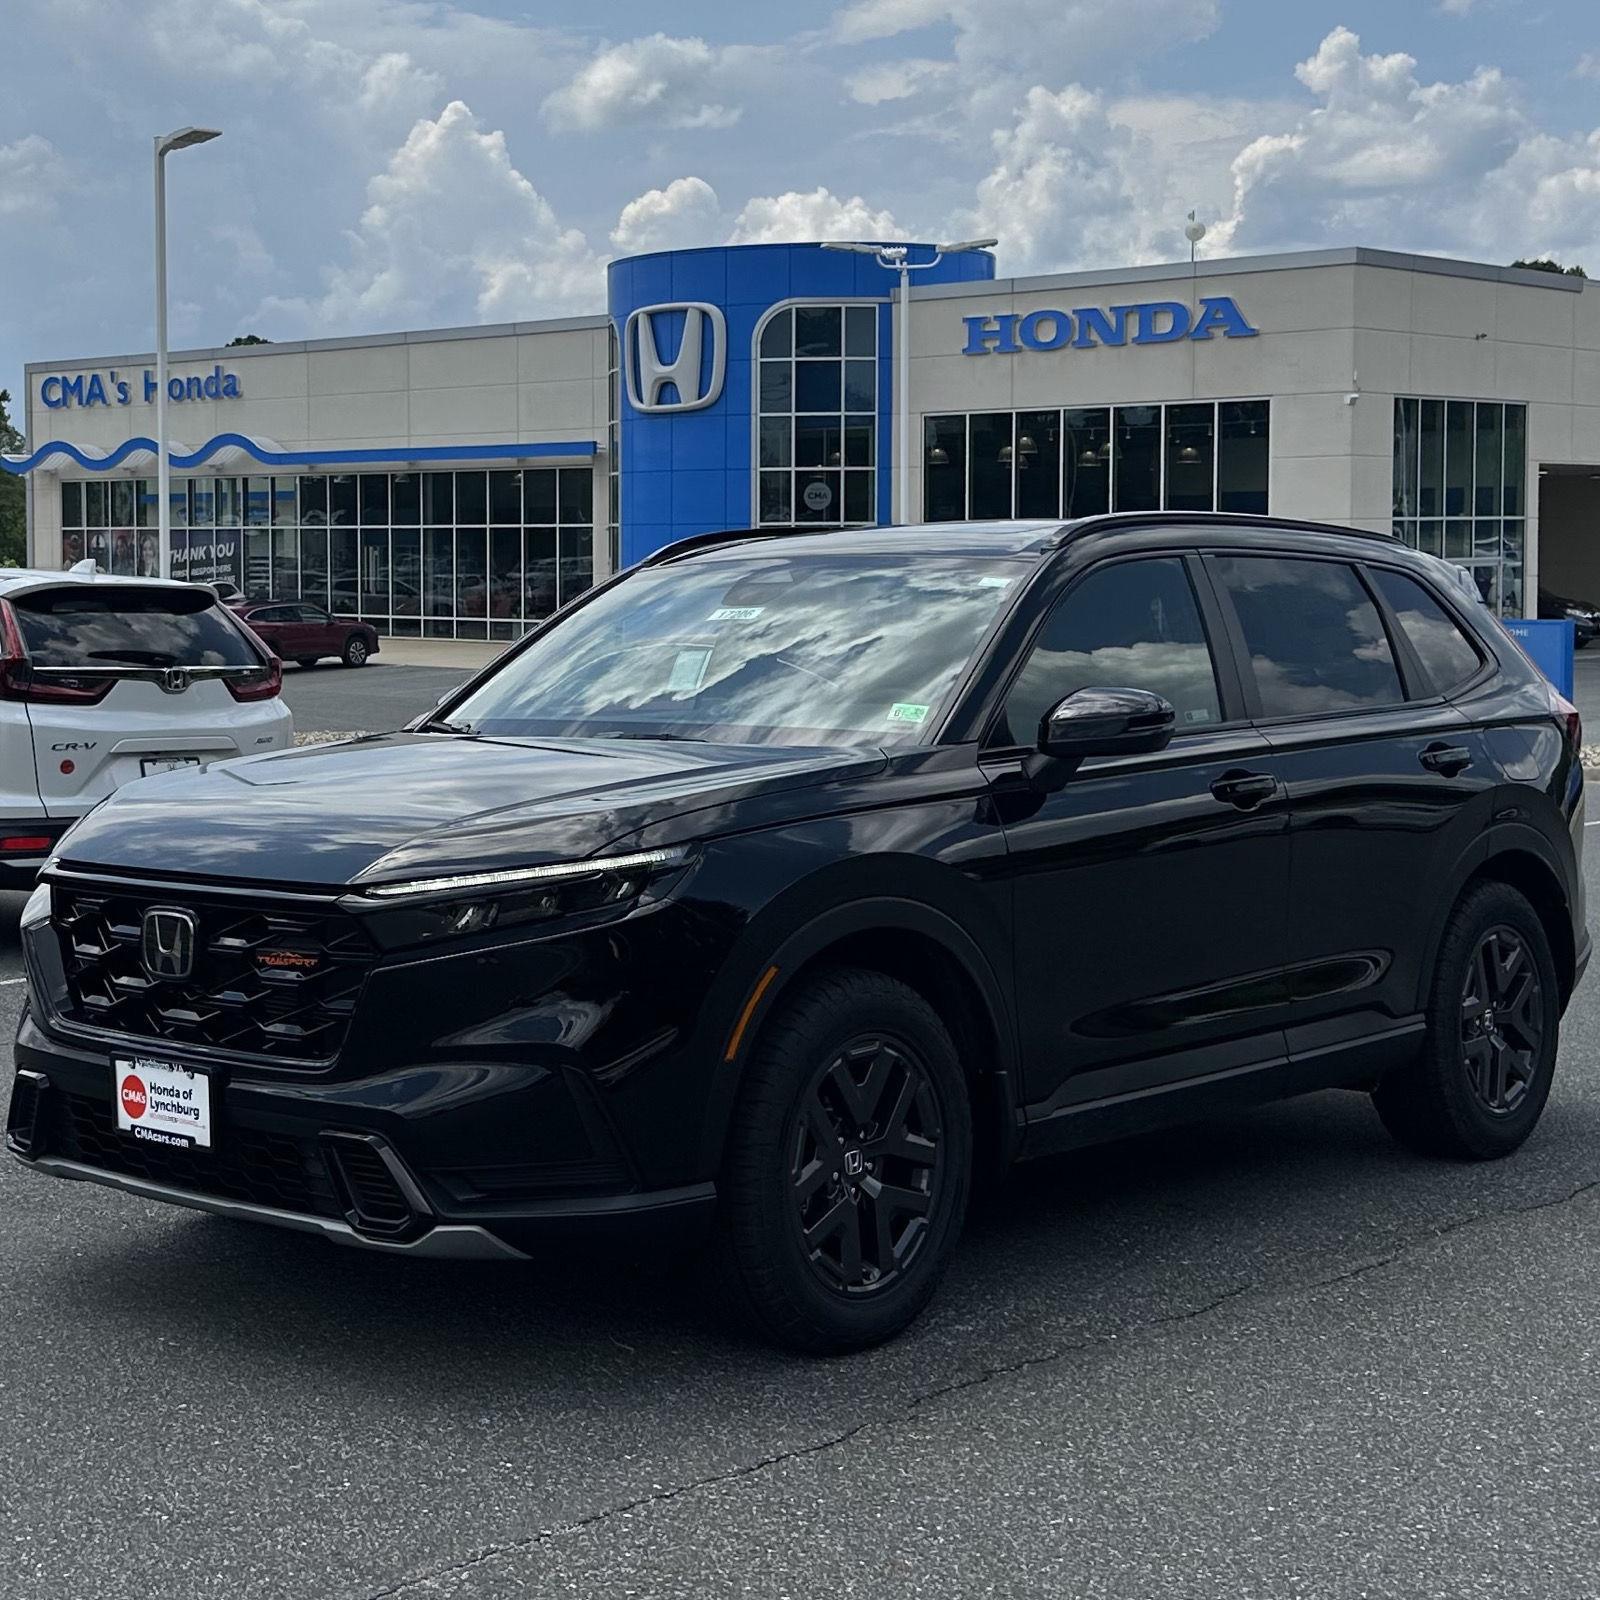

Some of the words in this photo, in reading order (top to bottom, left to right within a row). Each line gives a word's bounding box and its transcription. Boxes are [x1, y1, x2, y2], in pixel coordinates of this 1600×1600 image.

[961, 296, 1259, 355] HONDA
[41, 371, 130, 409] CMA's
[144, 365, 240, 402] Honda
[807, 491, 828, 500] CMA
[209, 542, 235, 559] YOU
[51, 742, 98, 751] CR-V
[122, 1088, 146, 1104] CMA's
[149, 1081, 181, 1099] Honda
[182, 1088, 193, 1101] of
[149, 1096, 200, 1121] Lynchburg
[134, 1127, 189, 1148] CMAcars.com
